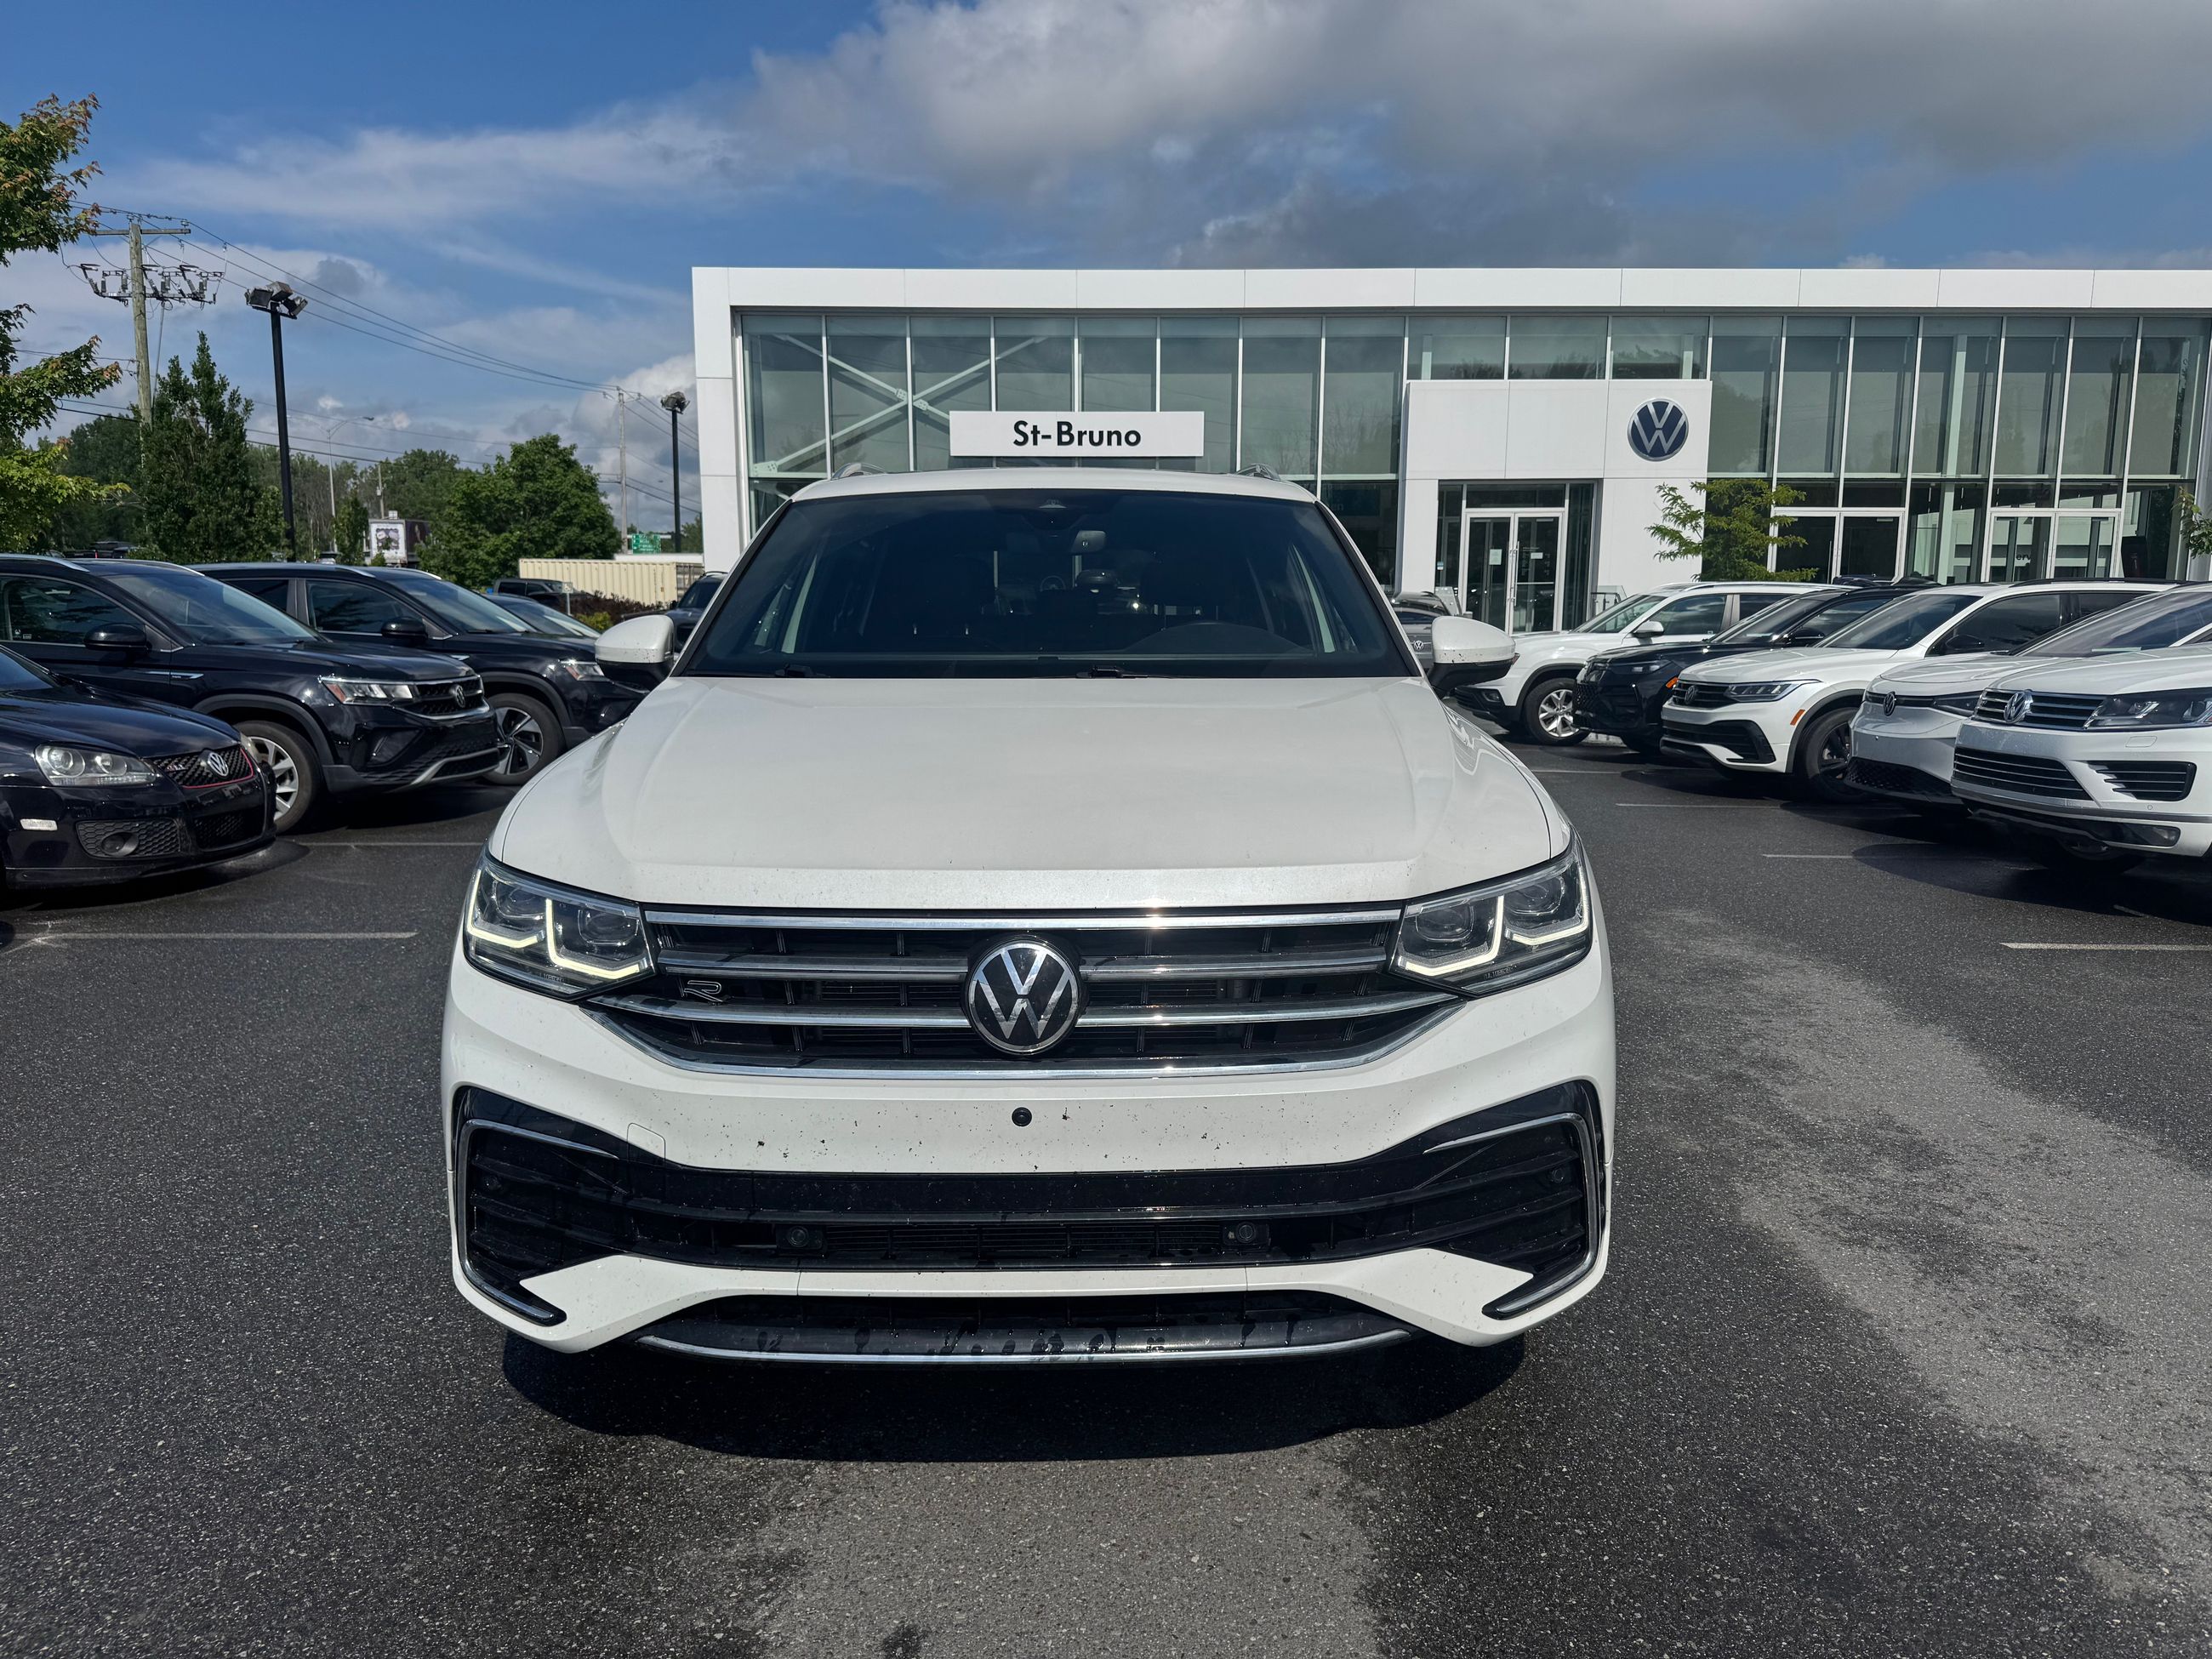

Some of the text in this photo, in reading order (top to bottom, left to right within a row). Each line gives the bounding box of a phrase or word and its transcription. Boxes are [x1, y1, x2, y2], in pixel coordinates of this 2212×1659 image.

[1013, 419, 1142, 447] St-Bruno
[1628, 398, 1689, 462] VW
[208, 752, 229, 777] VW
[684, 979, 723, 1002] R
[968, 939, 1079, 1053] VW
